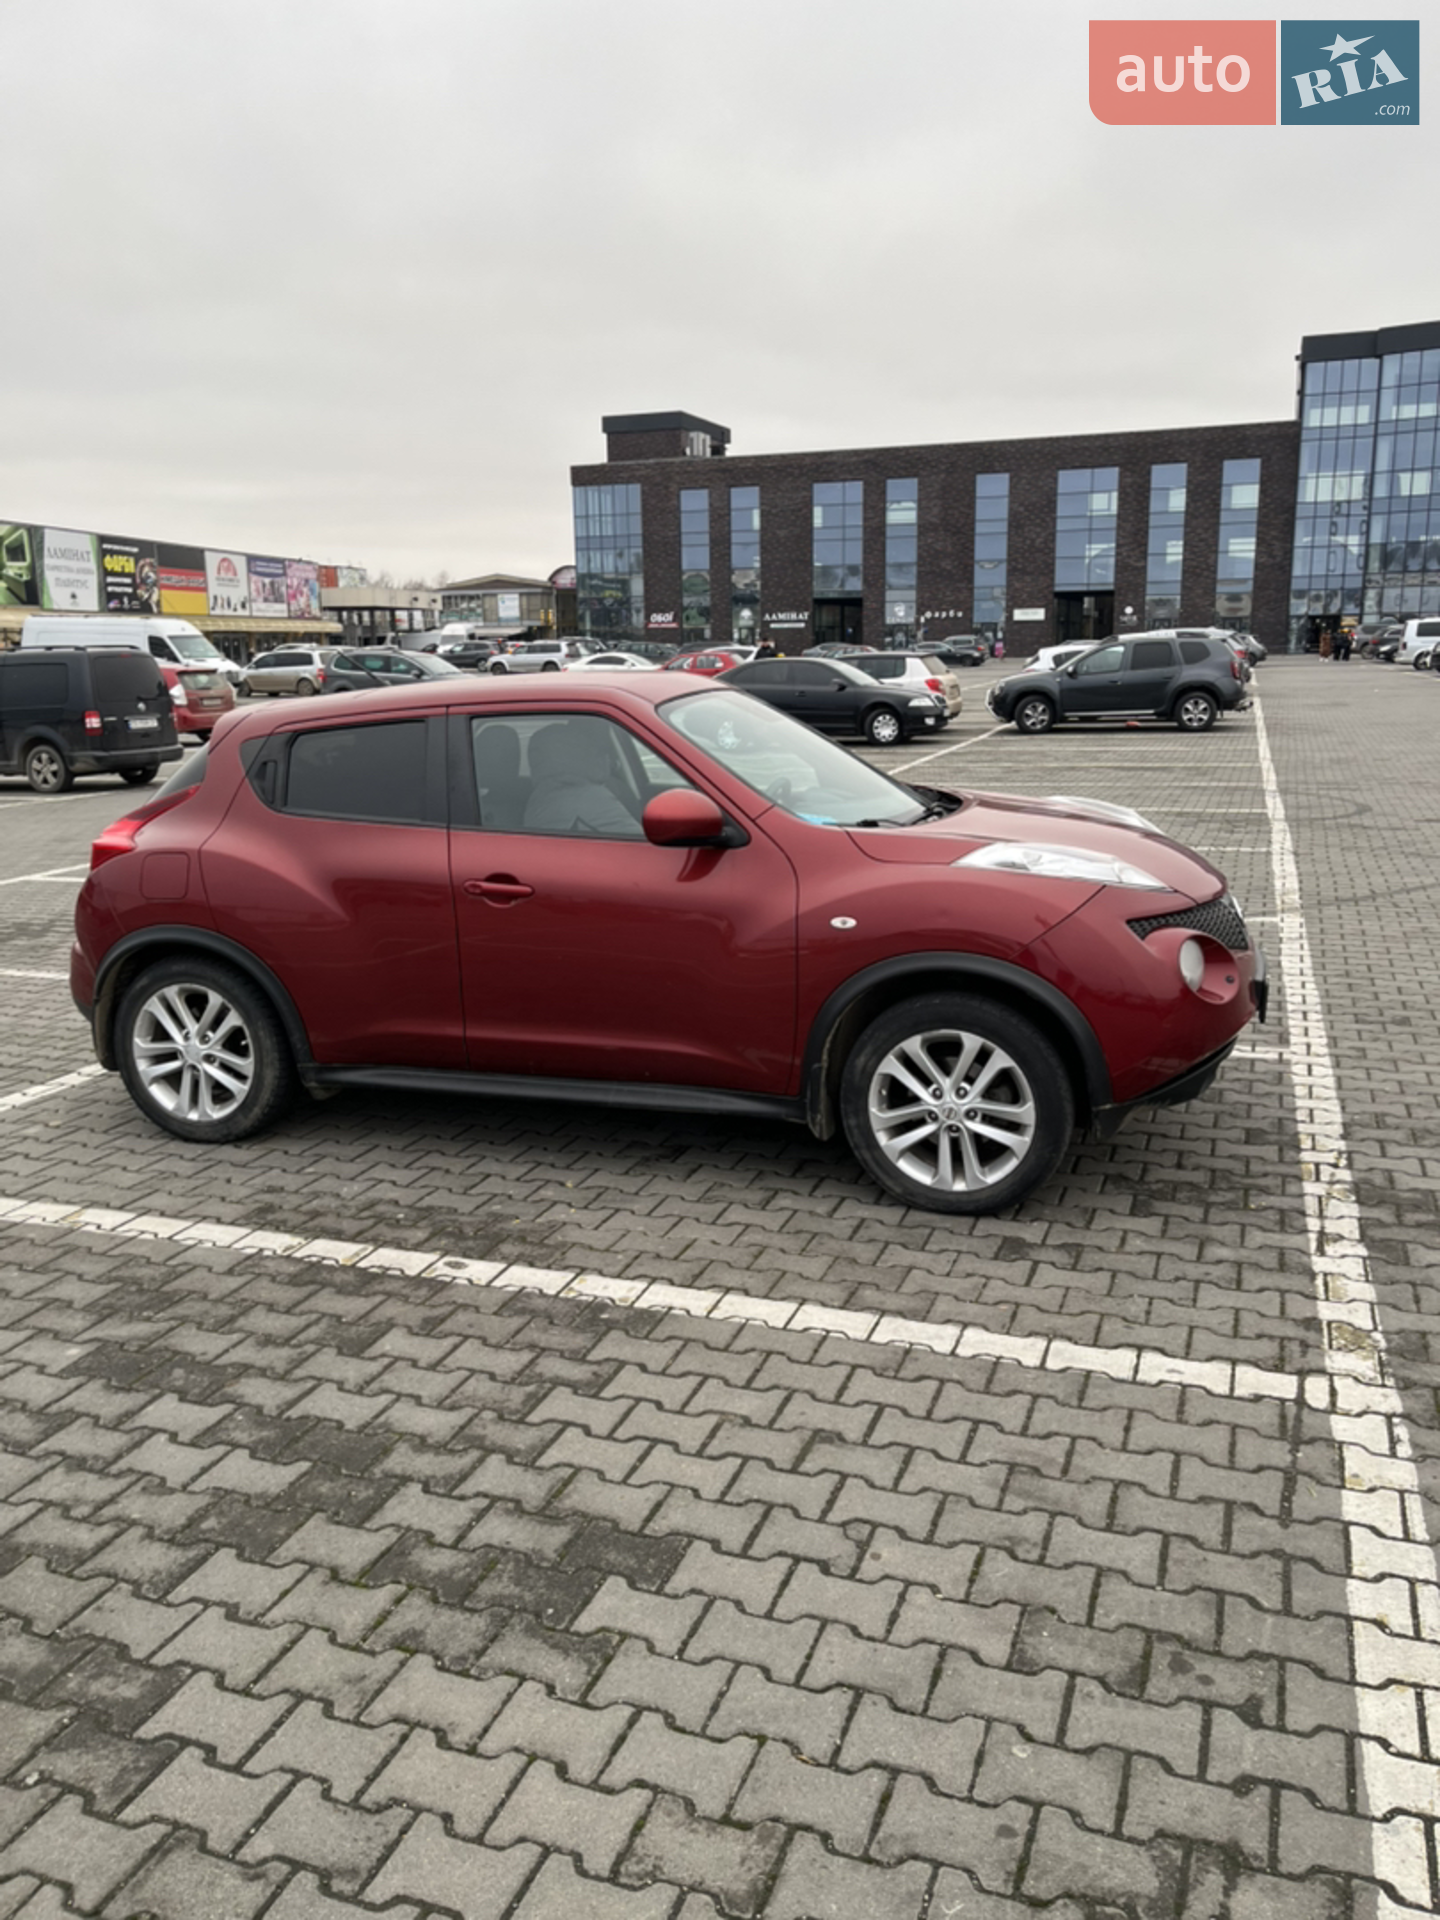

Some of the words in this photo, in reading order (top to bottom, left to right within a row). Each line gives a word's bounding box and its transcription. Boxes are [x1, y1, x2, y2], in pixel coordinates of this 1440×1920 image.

[46, 547, 91, 562] ЛАМІНАТ
[763, 611, 810, 621] ЛАМІНАТ
[924, 609, 963, 620] фарби
